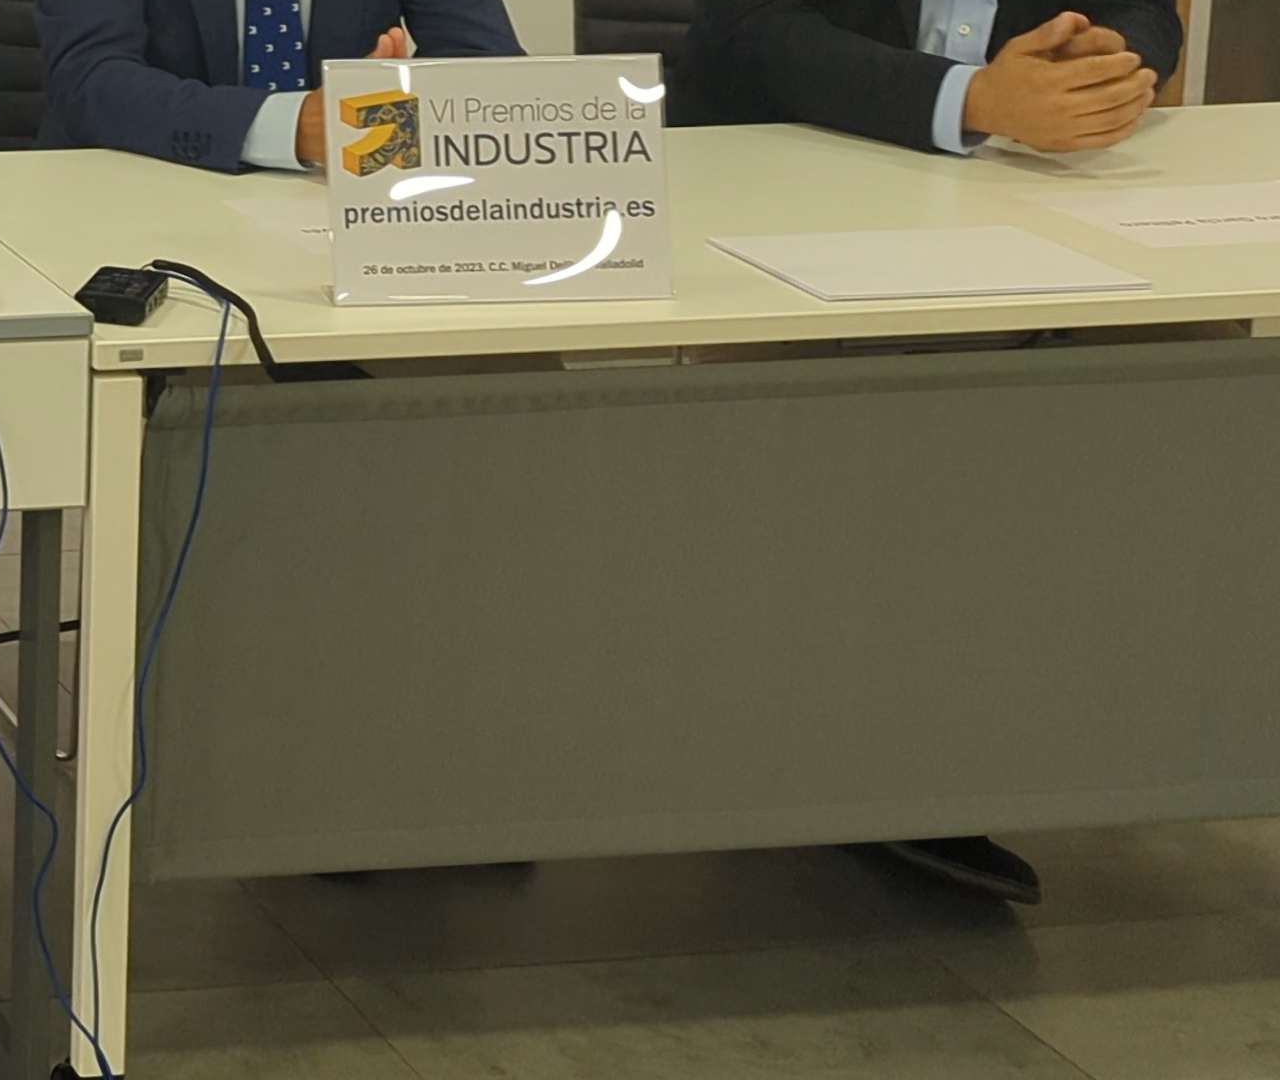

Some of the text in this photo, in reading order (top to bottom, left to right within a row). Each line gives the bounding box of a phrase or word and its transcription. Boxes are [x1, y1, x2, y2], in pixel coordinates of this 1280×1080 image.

[428, 95, 647, 124] VI Premios de la
[433, 129, 653, 168] INDUSTRIA
[343, 196, 656, 229] premiosdelaindustria.es
[362, 264, 378, 275] 26
[380, 264, 394, 275] de
[396, 263, 437, 274] octubre
[438, 263, 452, 273] de
[511, 260, 547, 273] Miguel
